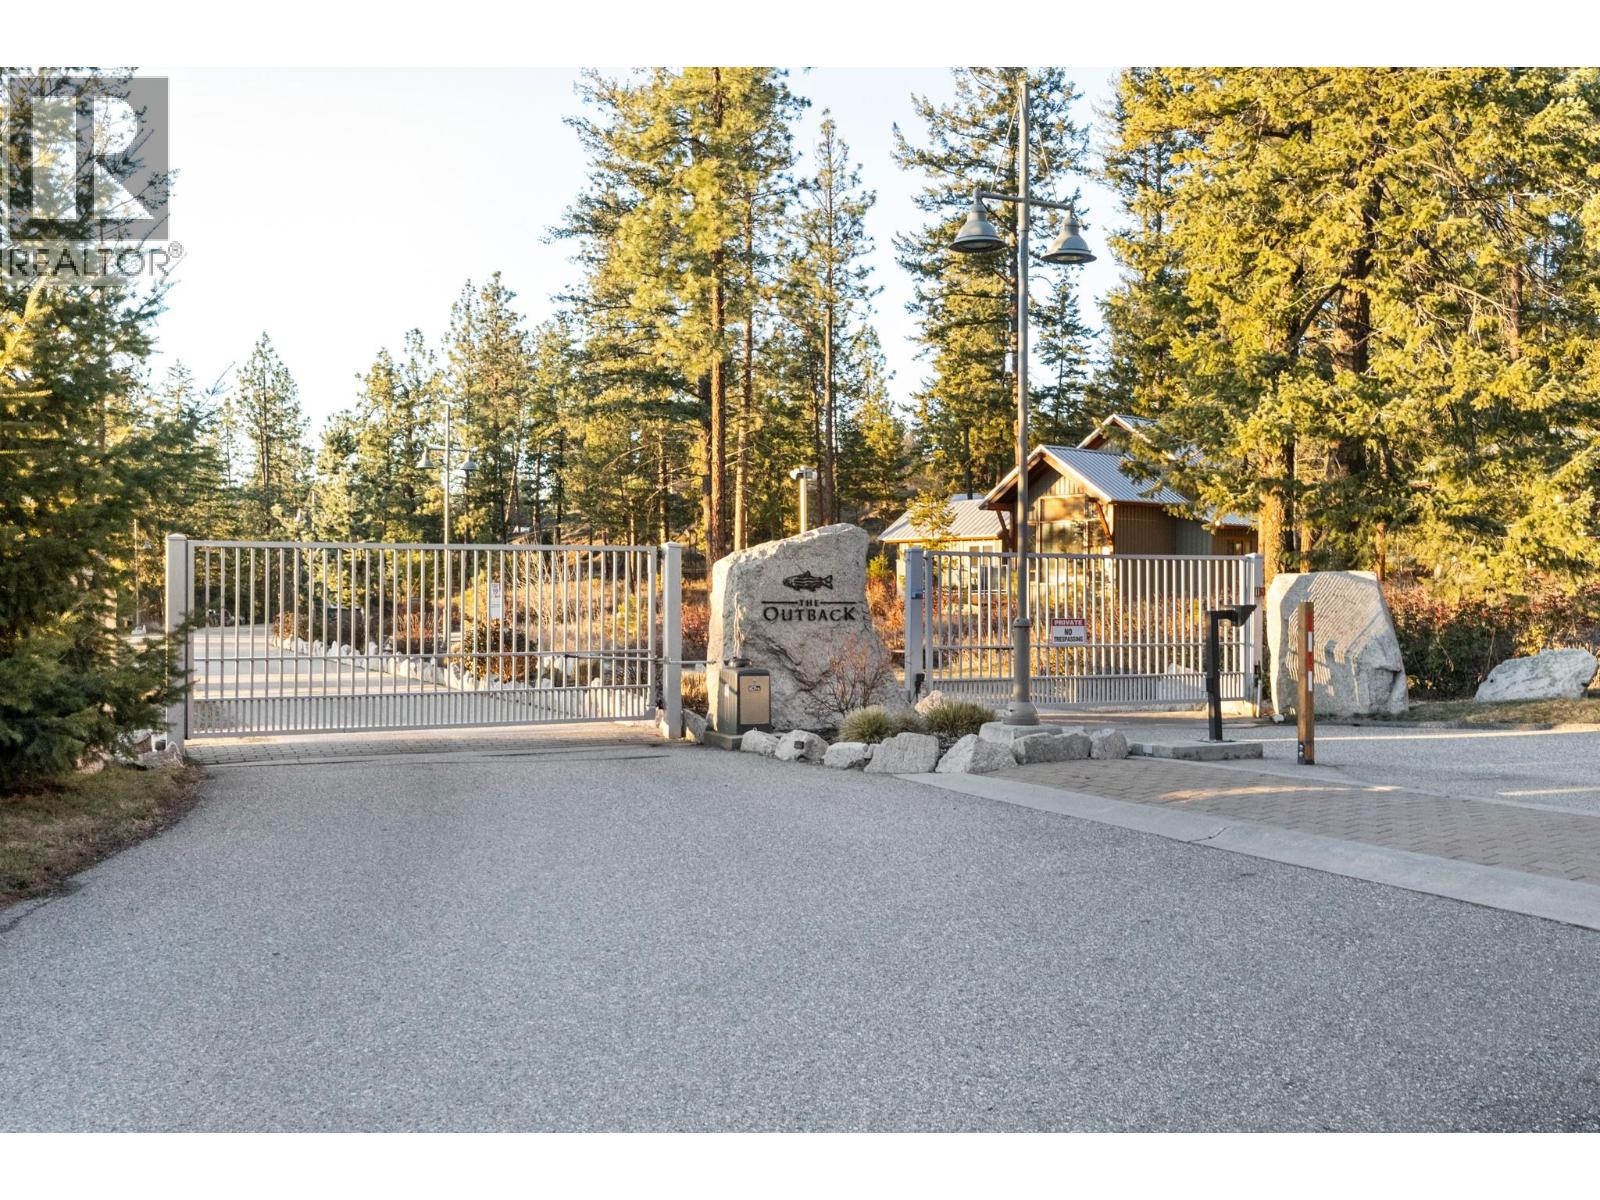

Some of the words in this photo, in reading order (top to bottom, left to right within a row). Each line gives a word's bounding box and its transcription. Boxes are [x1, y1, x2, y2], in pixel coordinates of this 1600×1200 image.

[799, 599, 820, 607] THE
[763, 606, 856, 622] OUTBACK
[1064, 628, 1073, 636] NO
